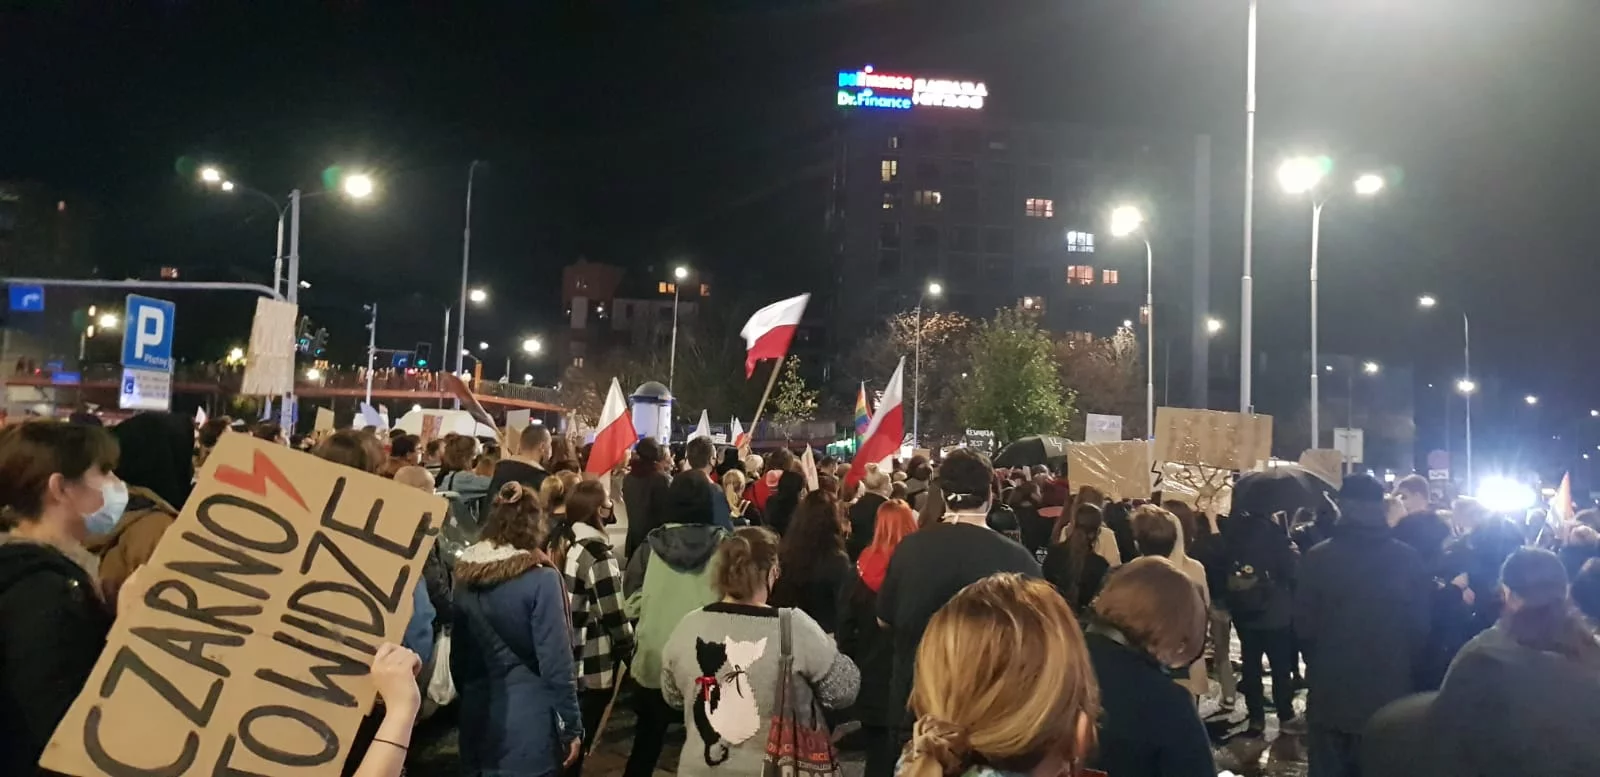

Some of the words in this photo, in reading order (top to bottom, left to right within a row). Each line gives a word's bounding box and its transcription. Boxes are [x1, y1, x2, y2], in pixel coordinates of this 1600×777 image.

[838, 88, 911, 108] Dr.Finance
[134, 305, 164, 359] P
[83, 493, 299, 777] CZARNO
